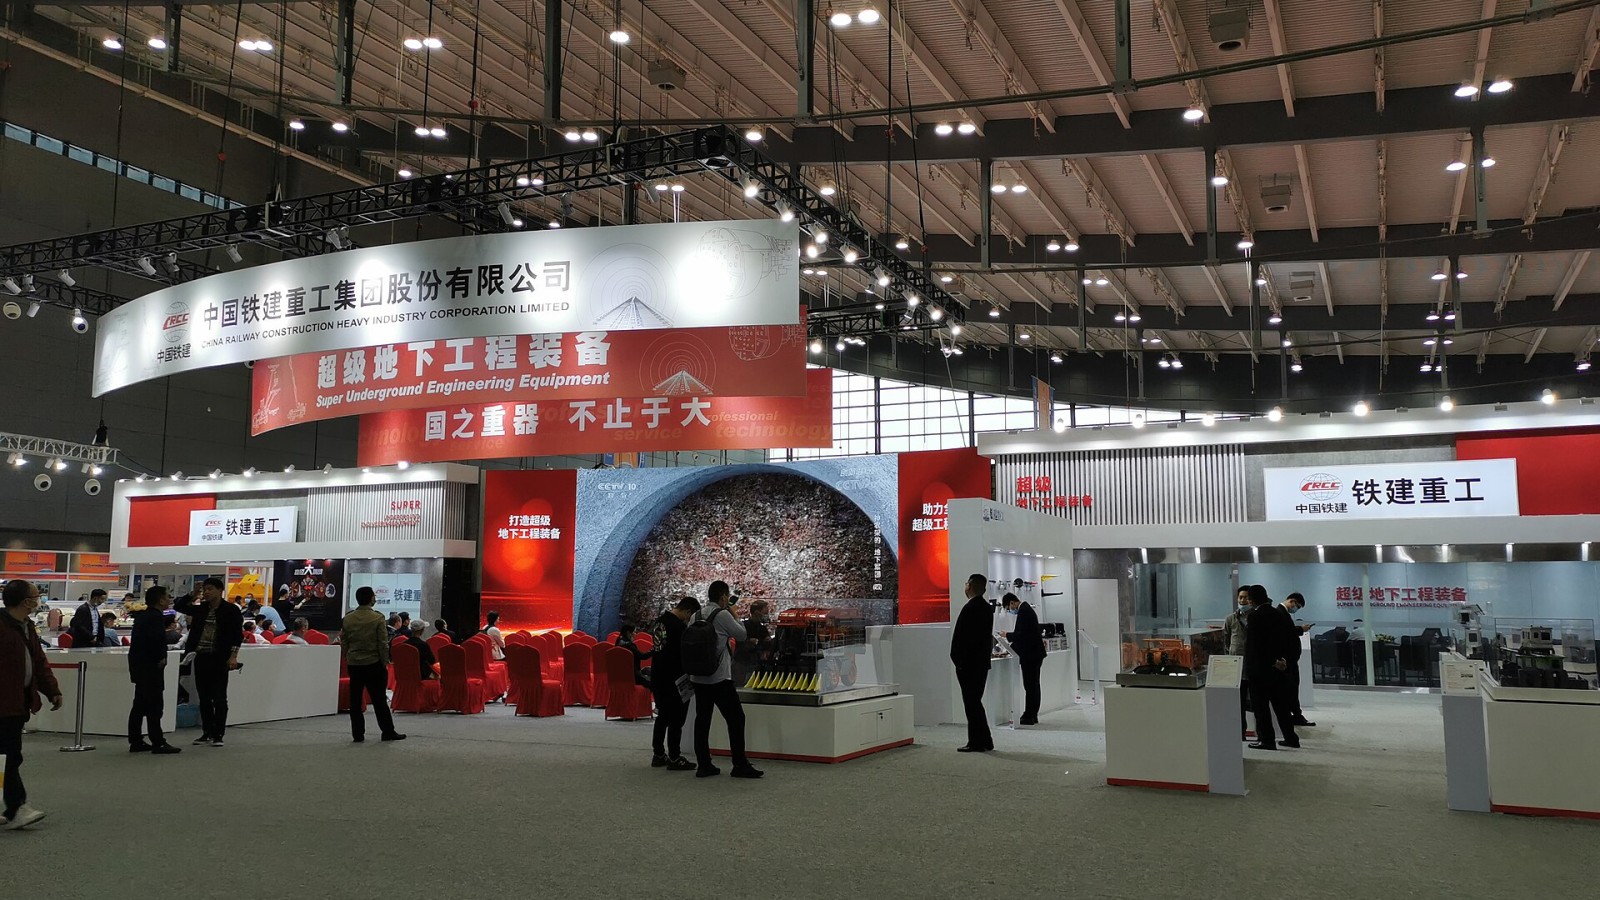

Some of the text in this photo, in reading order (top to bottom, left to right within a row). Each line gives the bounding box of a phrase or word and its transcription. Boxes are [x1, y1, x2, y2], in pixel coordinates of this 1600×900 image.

[203, 260, 571, 331] 中国铁建重工集团股份有限公司
[201, 302, 570, 349] CHINA RAILWAY CONSTRUCTION HEAVY INDUSTRY CORPORATION LIMITED
[157, 343, 191, 363] 中国铁建
[317, 331, 611, 390] 超级地下工程装备
[316, 372, 611, 408] Super Underground Engineering Equipment
[424, 402, 539, 441] 国之重器
[568, 396, 711, 432] 不止于大
[627, 482, 637, 491] 10
[1016, 475, 1052, 493] 超级
[1301, 481, 1343, 492] CRCC
[1351, 476, 1485, 506] 铁建重工
[391, 500, 421, 511] SUPER
[1016, 494, 1092, 509] 地下工程装备
[1295, 502, 1348, 514] 中国铁建
[226, 517, 280, 536] 铁建重工
[508, 514, 551, 527] 打造超级
[498, 528, 561, 540] 地下工程装备
[1336, 586, 1467, 602] 超级地下工程装备
